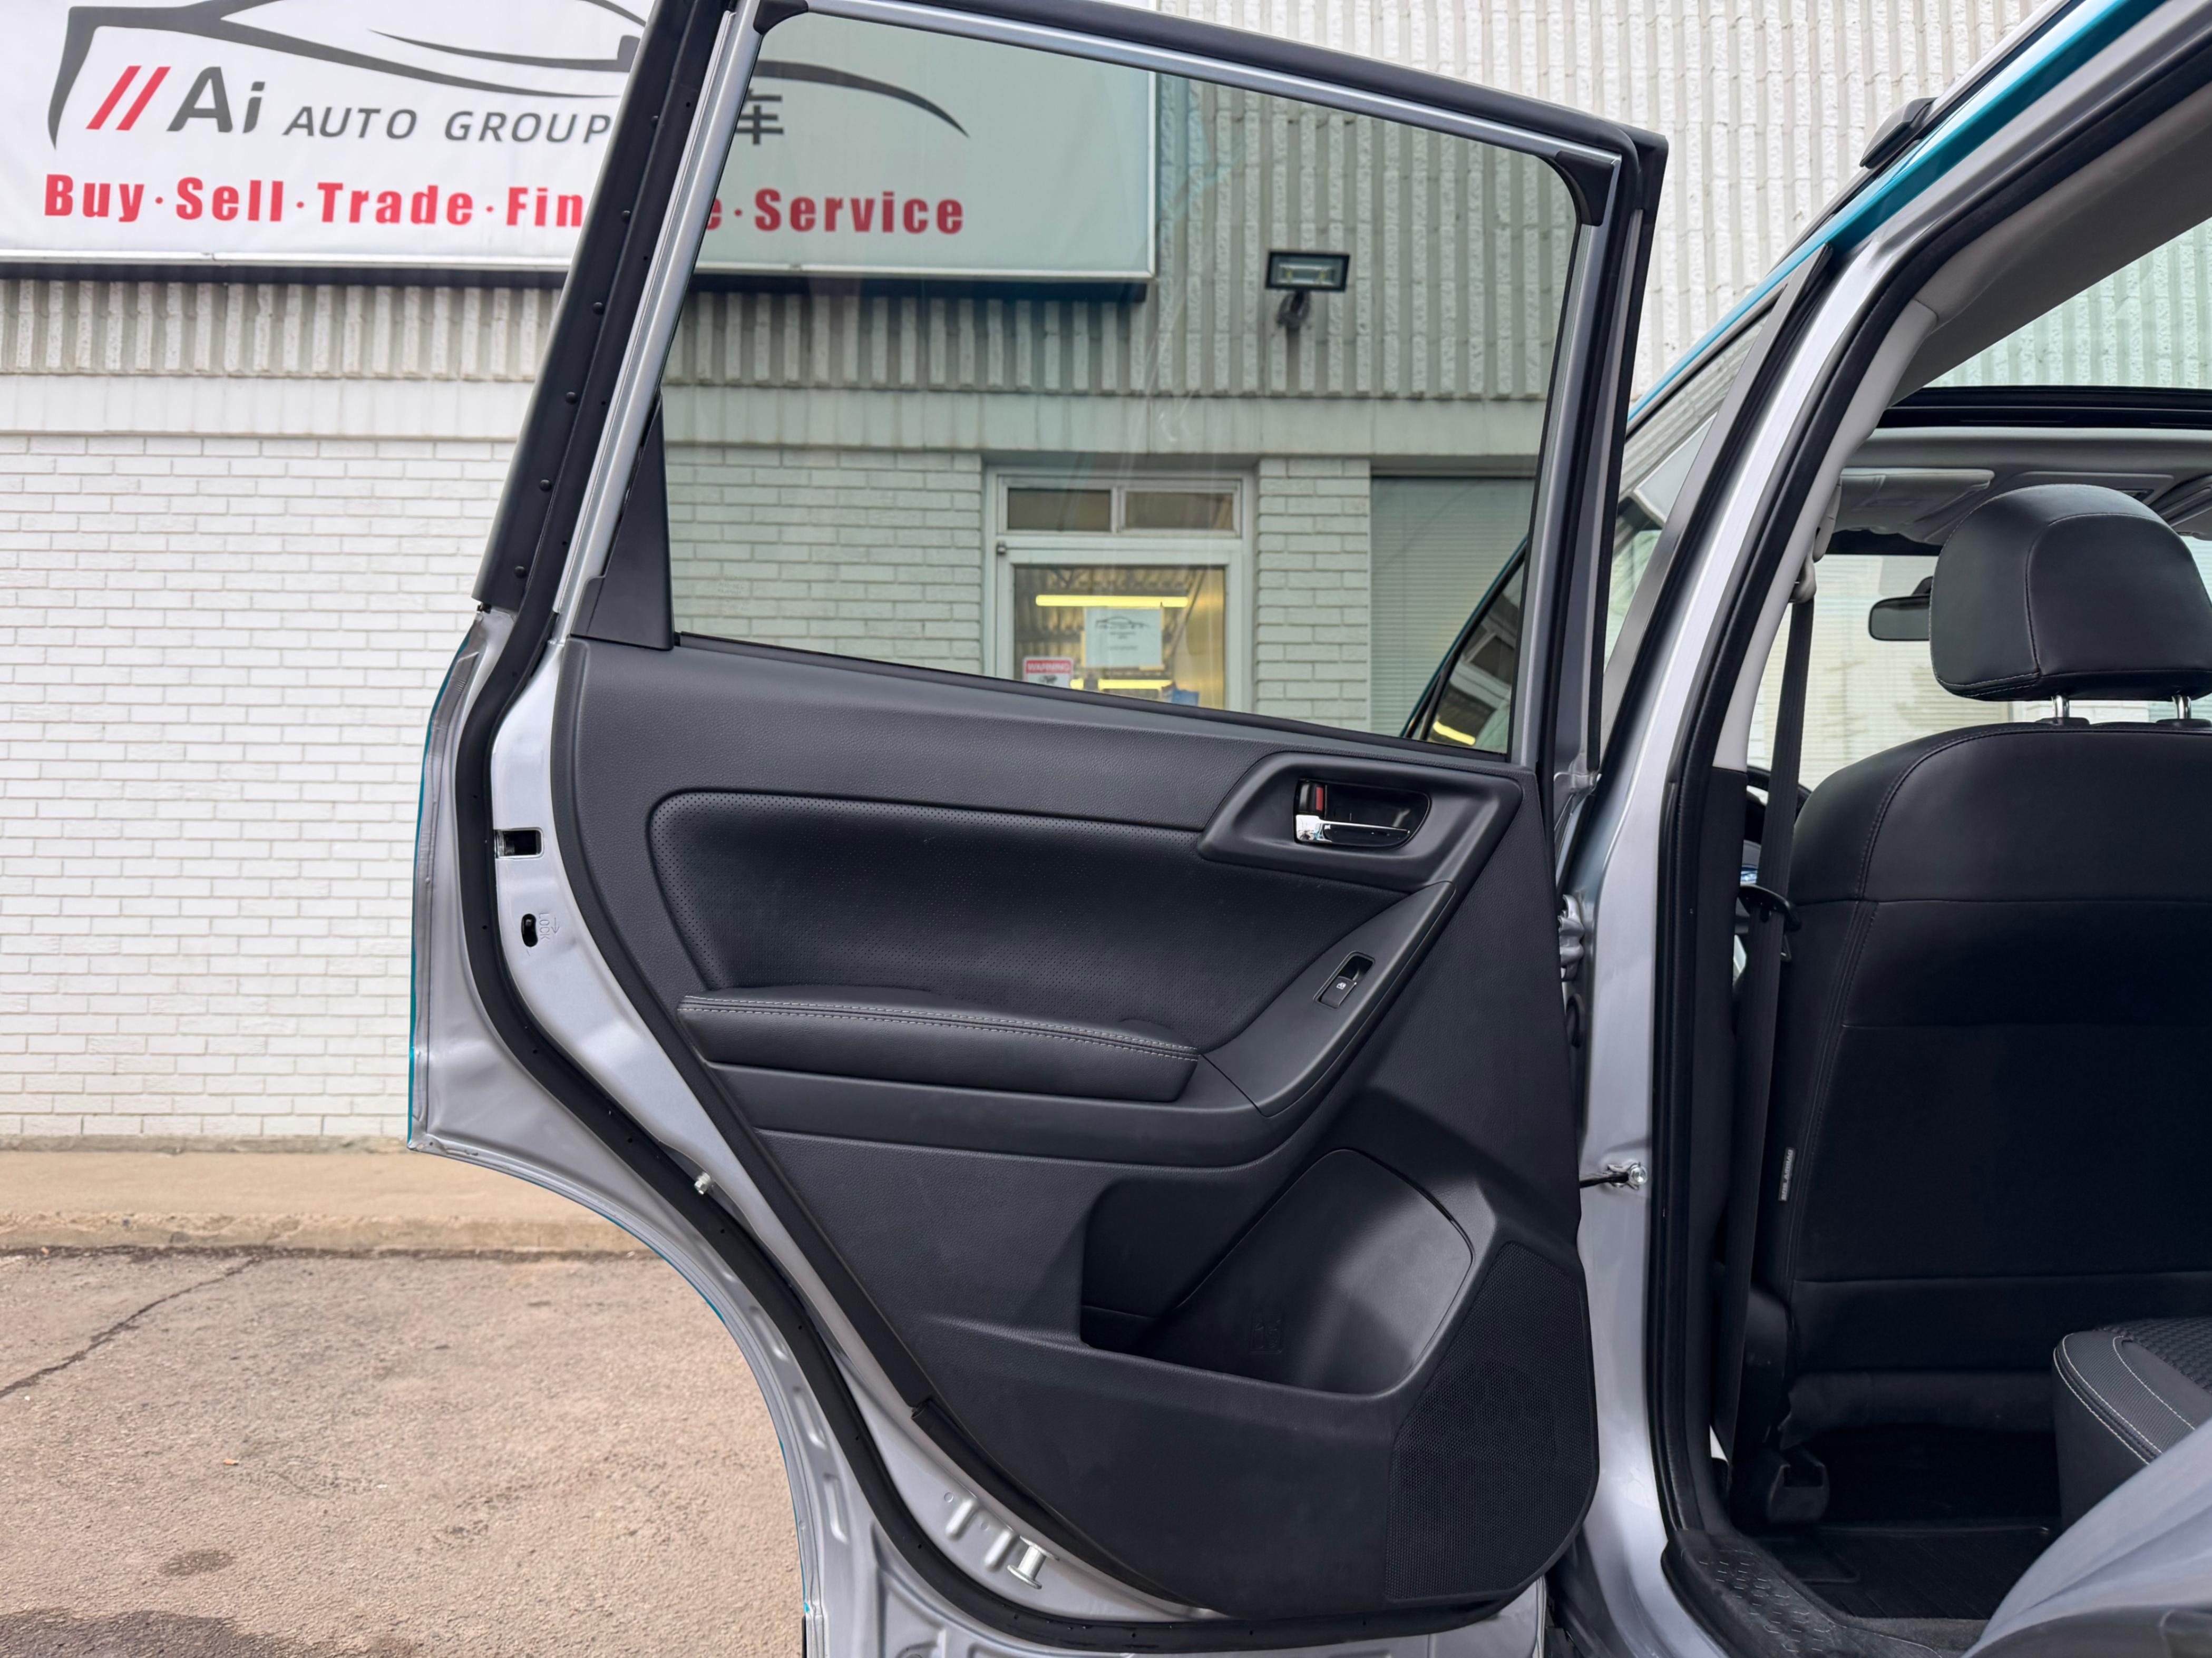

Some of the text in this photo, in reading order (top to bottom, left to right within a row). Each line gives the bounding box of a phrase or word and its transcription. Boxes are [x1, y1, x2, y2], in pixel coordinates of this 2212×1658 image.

[282, 106, 417, 139] AUTO
[445, 111, 611, 143] GROUP
[44, 174, 145, 223] Buy
[176, 177, 284, 222] Sell
[317, 182, 473, 226] Trade
[755, 189, 963, 234] Service
[539, 913, 550, 940] LOCK
